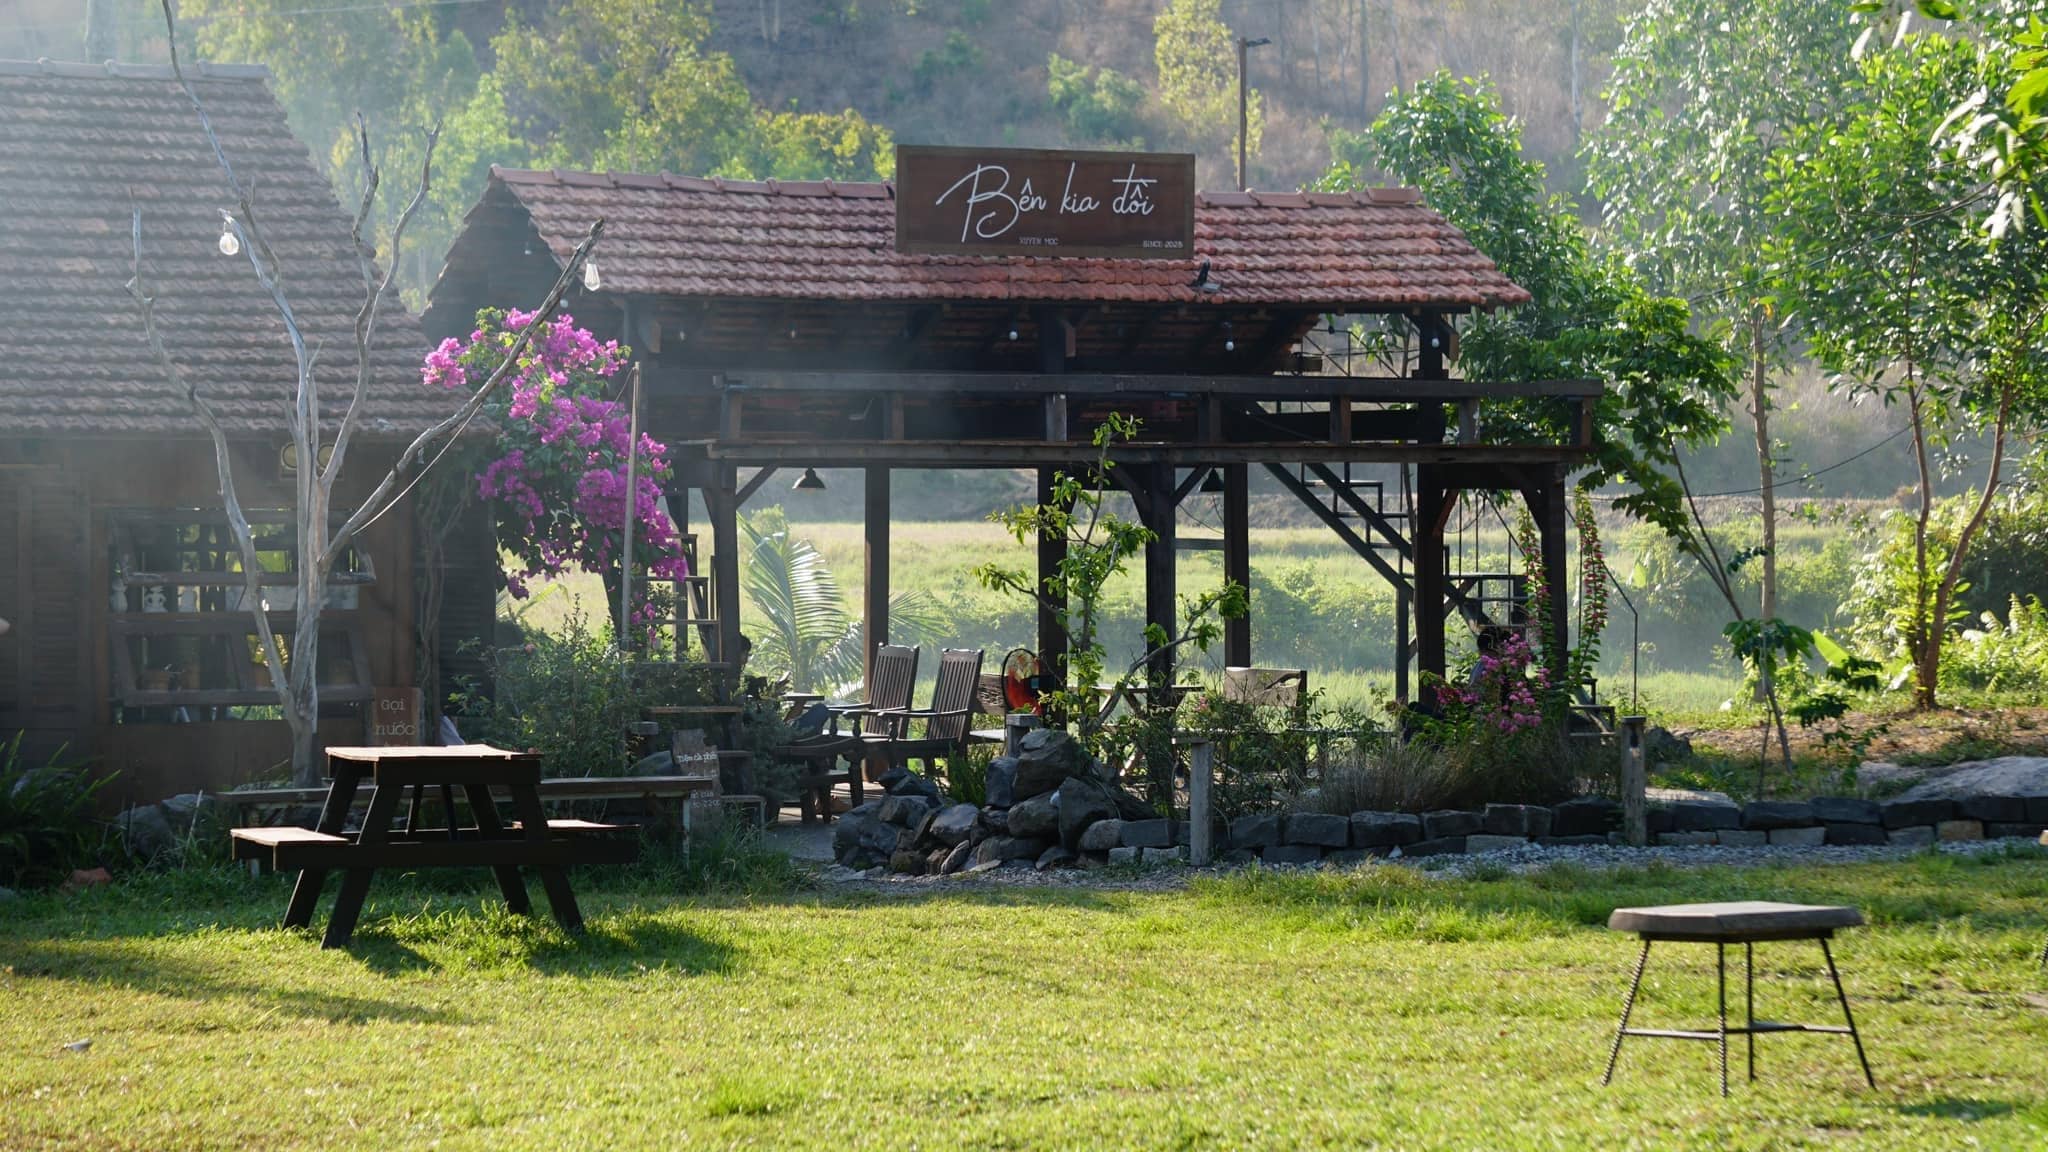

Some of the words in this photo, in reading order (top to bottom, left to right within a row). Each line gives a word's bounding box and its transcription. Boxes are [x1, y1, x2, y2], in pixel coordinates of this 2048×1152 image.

[936, 164, 1047, 243] Bên
[1060, 161, 1100, 214] kia
[1112, 163, 1158, 215] đồi
[1143, 240, 1161, 248] SINCE
